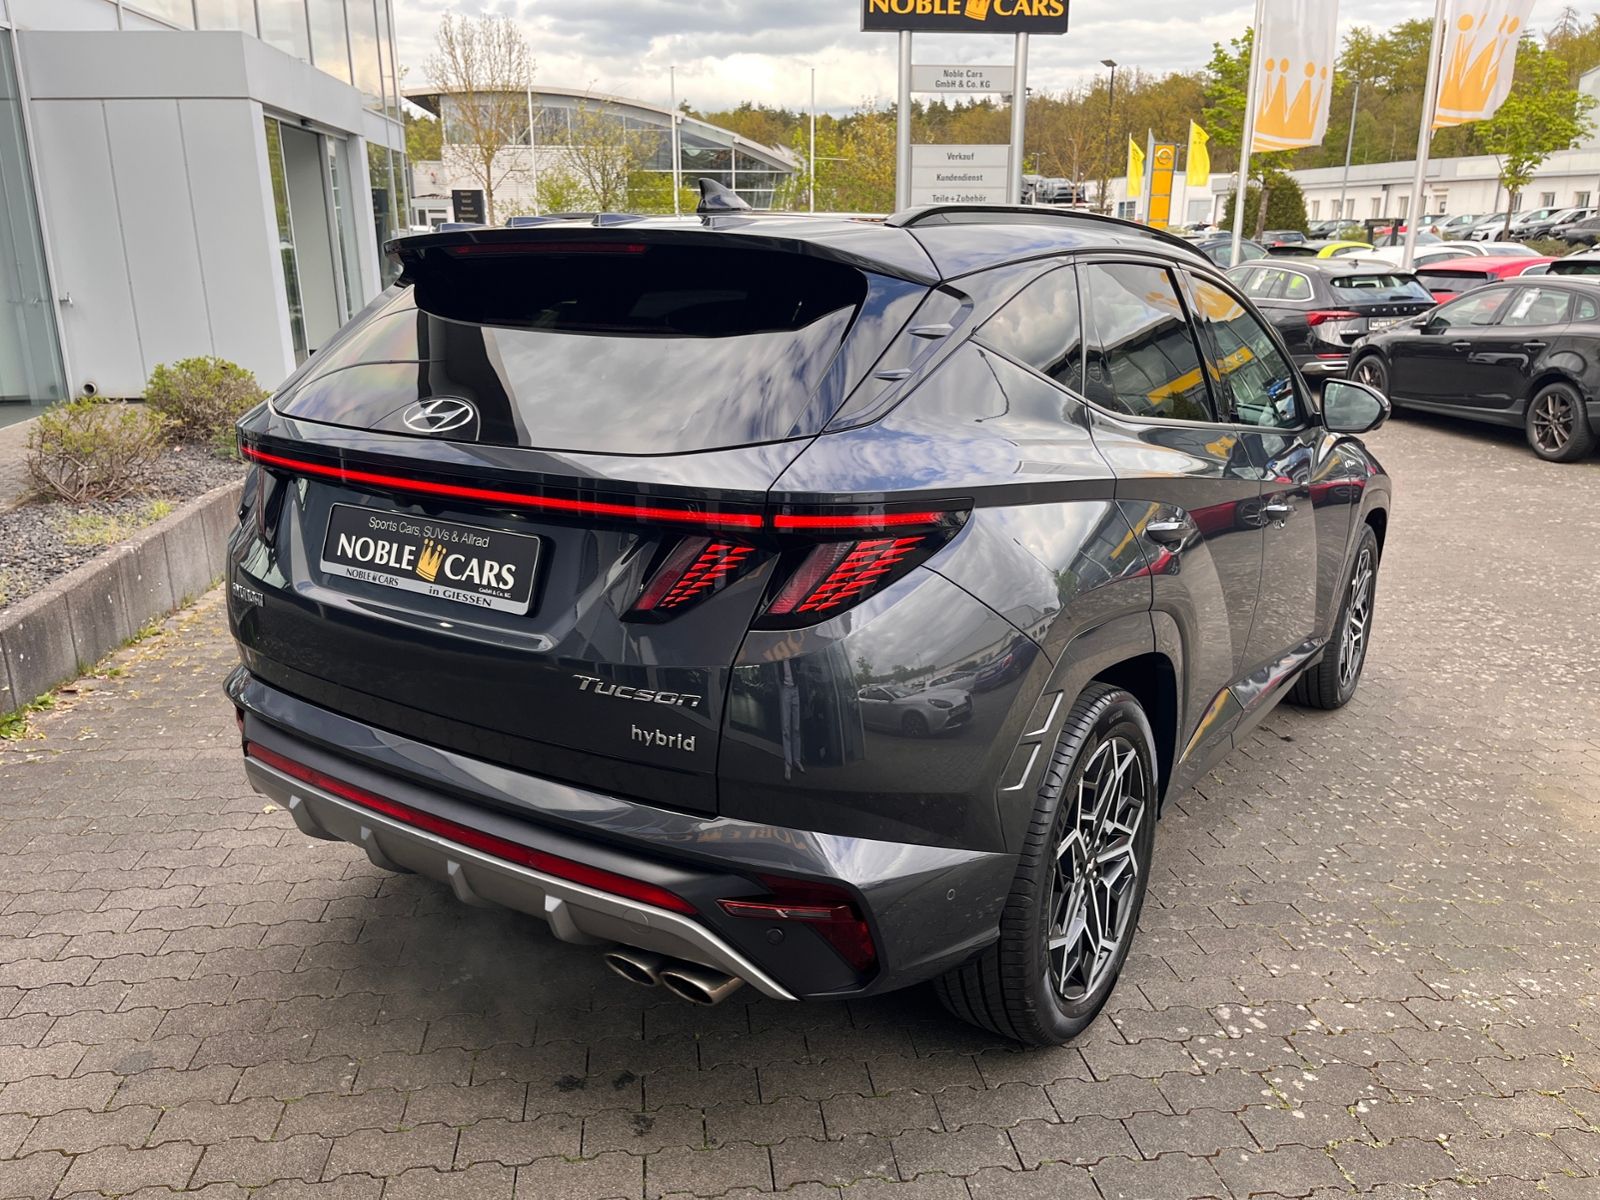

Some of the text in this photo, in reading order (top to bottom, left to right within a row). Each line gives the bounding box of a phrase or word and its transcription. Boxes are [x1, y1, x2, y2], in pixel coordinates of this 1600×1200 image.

[868, 0, 1065, 17] NOBLE CARS
[943, 69, 983, 78] Noble Cars
[935, 80, 991, 88] GmbH & Co. KG
[946, 152, 975, 161] Verkauf
[936, 173, 983, 182] Kundendienst
[369, 516, 490, 548] Sports Cars, SUVs & Allrad
[336, 532, 517, 590] NOBLE CARS
[345, 567, 399, 587] NOBLE CARS
[428, 585, 493, 607] in GIESSEN
[631, 724, 696, 751] hybrid
